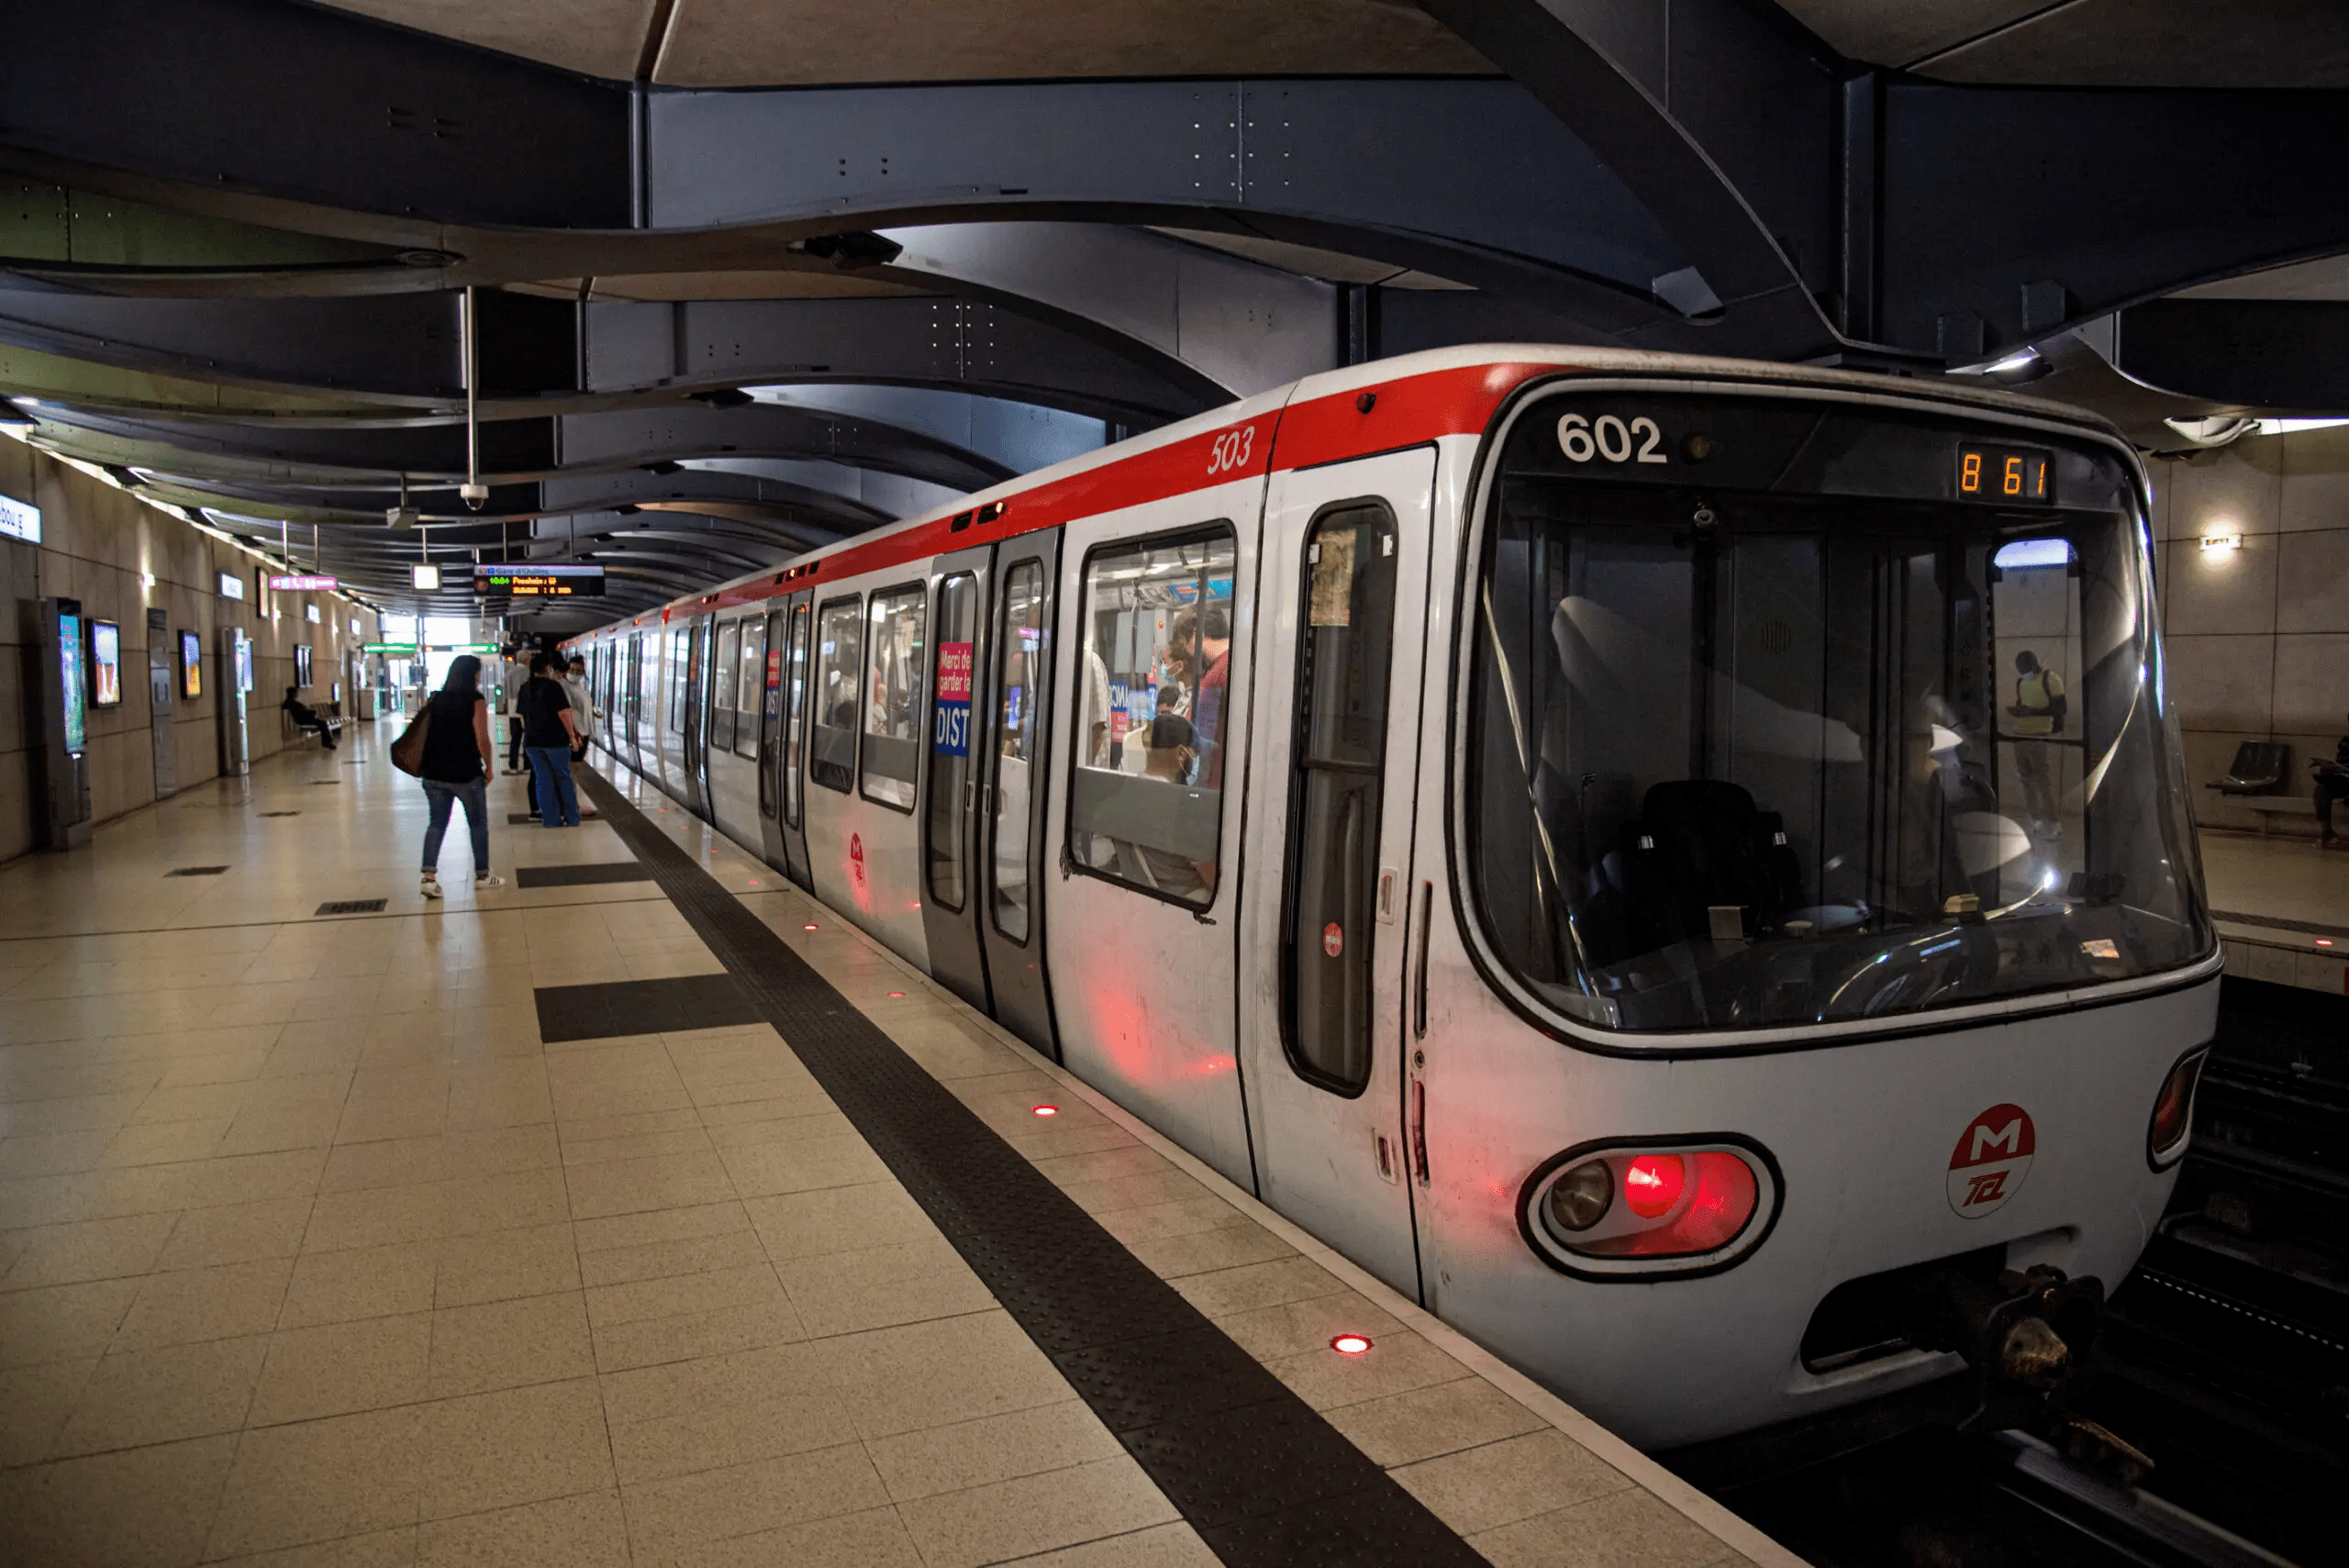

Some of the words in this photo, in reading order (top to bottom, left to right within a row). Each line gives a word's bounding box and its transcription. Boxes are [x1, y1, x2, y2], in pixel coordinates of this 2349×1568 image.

[1207, 426, 1255, 475] 503
[1557, 413, 1668, 463] 602
[2003, 457, 2046, 495] 61
[941, 650, 961, 670] Merci
[962, 650, 970, 670] de
[940, 672, 963, 696] garder
[937, 707, 970, 748] DIST
[1970, 1118, 2021, 1161] M
